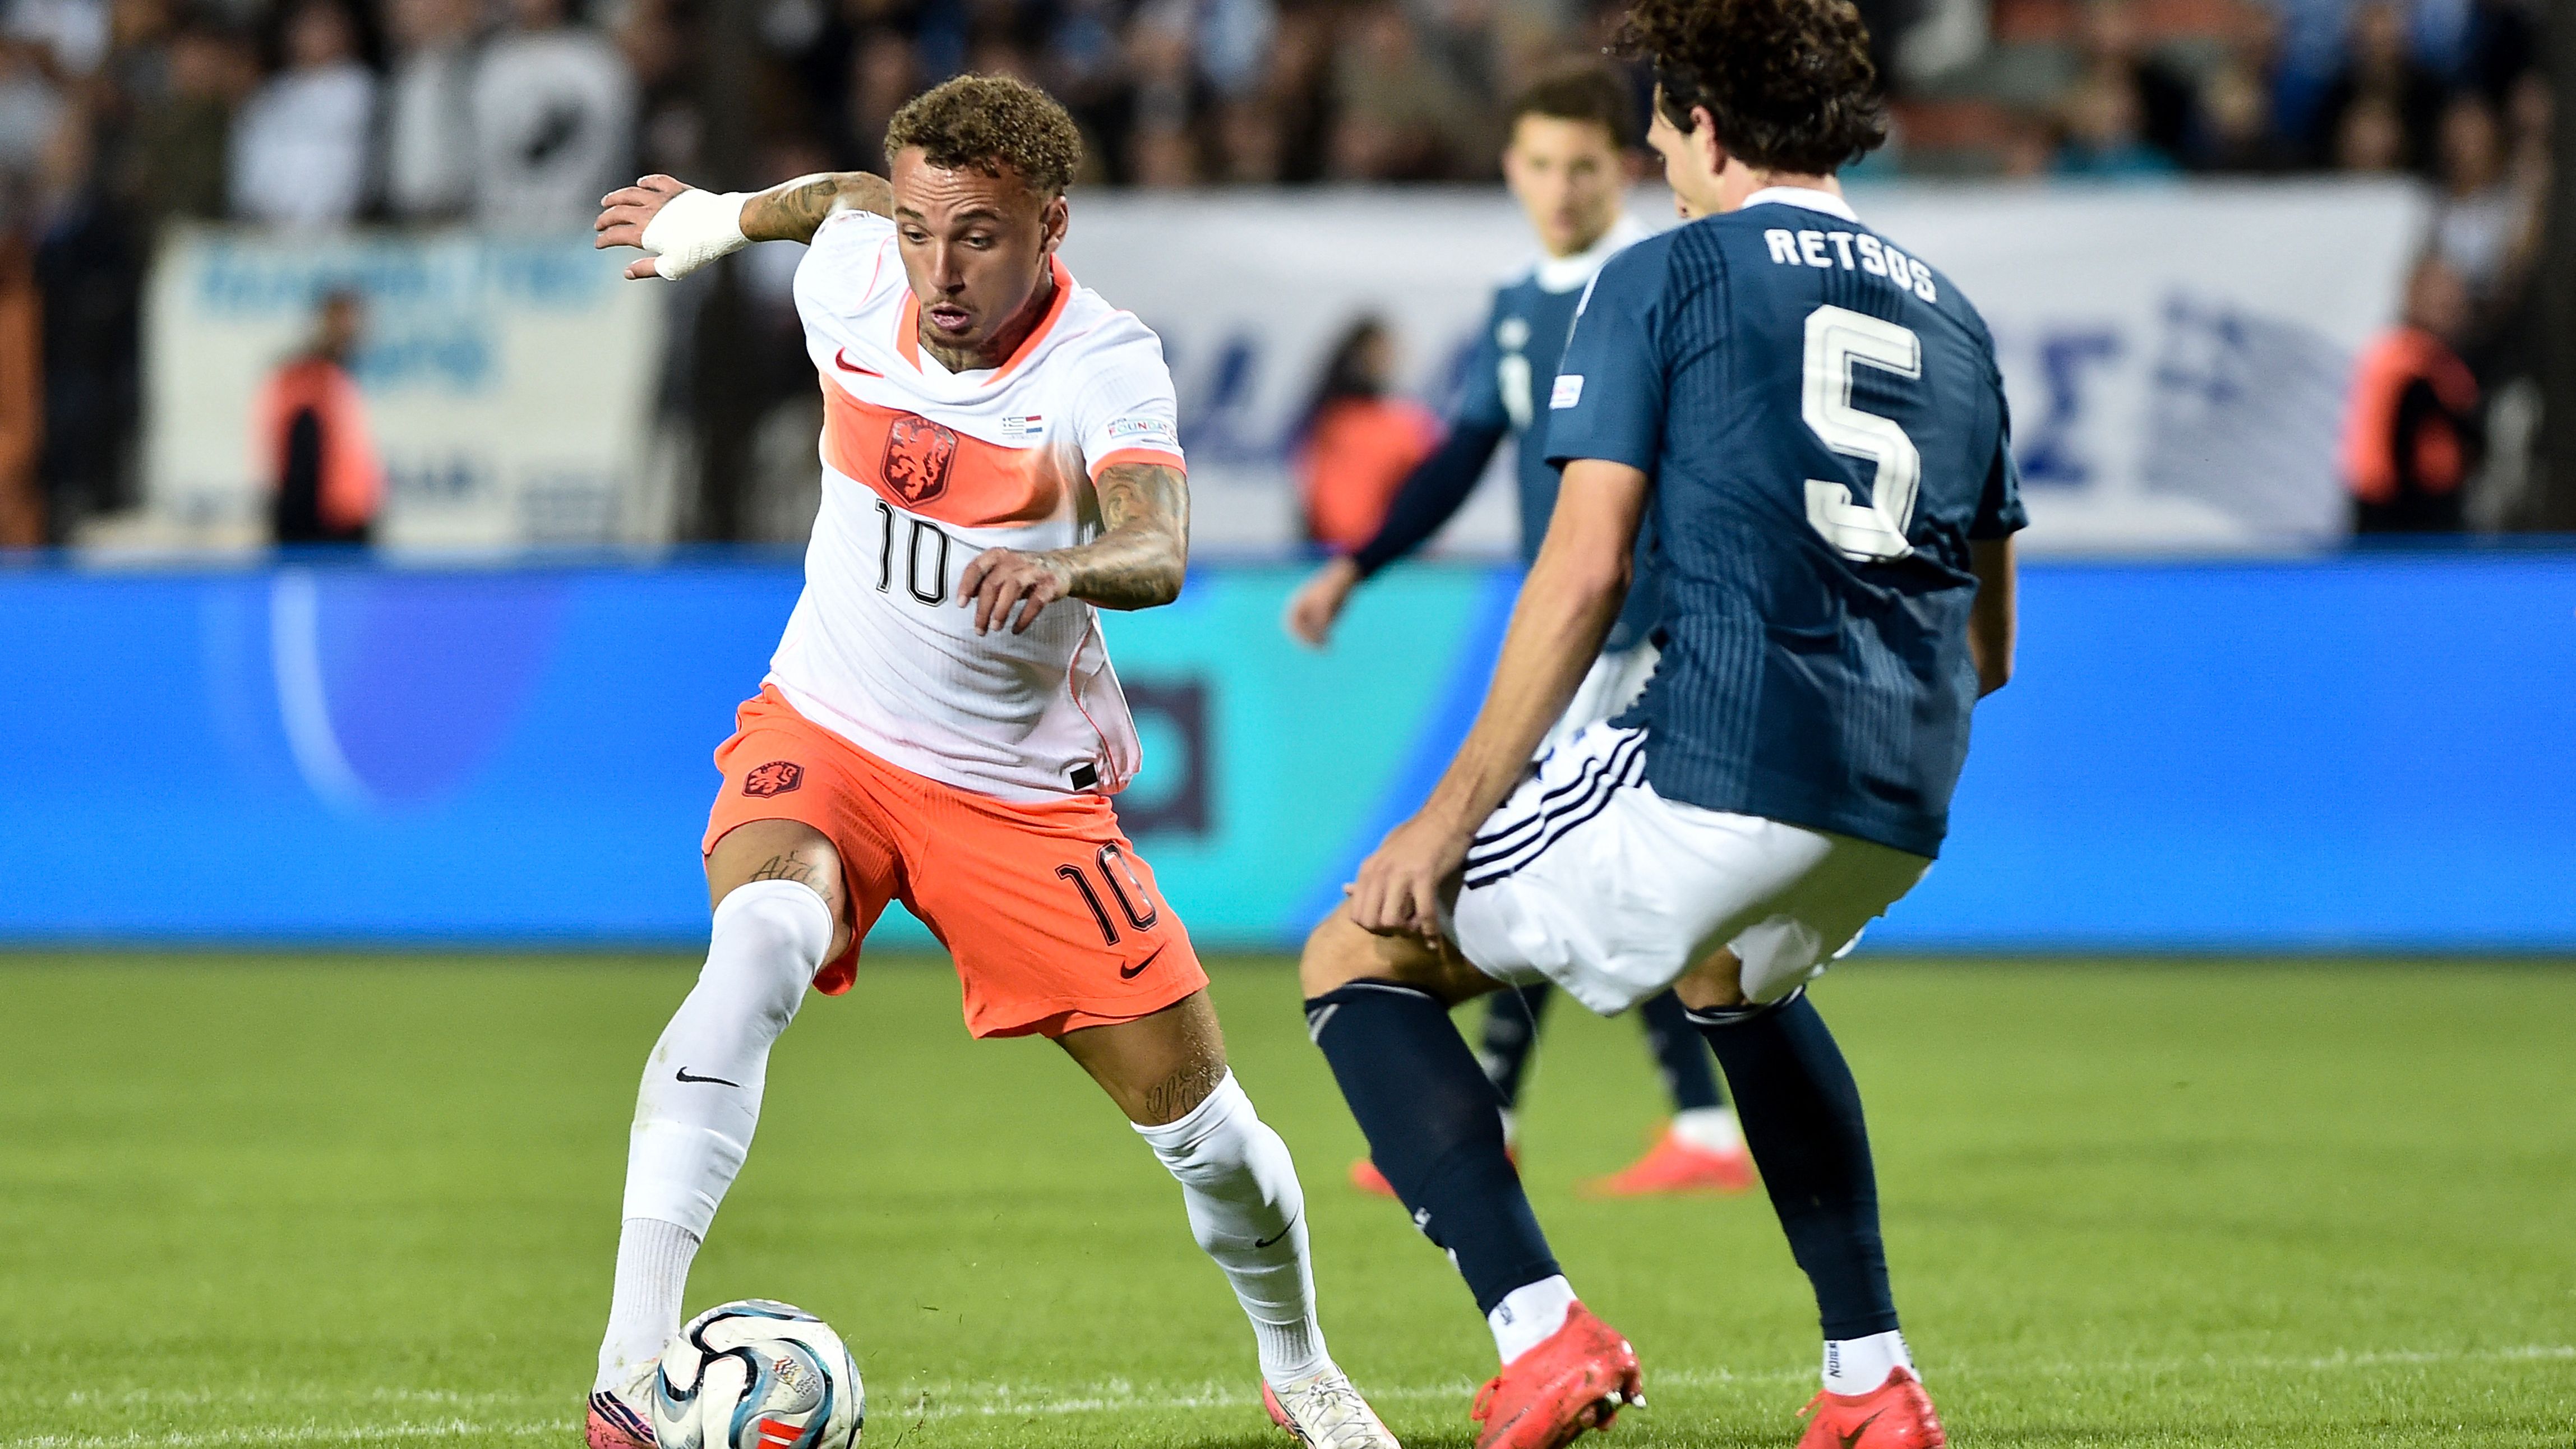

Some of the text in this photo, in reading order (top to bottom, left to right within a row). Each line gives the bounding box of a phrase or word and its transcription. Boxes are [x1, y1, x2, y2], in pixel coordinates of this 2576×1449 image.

[1764, 229, 1937, 303] RETSOS
[1802, 304, 1921, 562] 5
[875, 498, 951, 607] 10
[1055, 843, 1158, 946] 10
